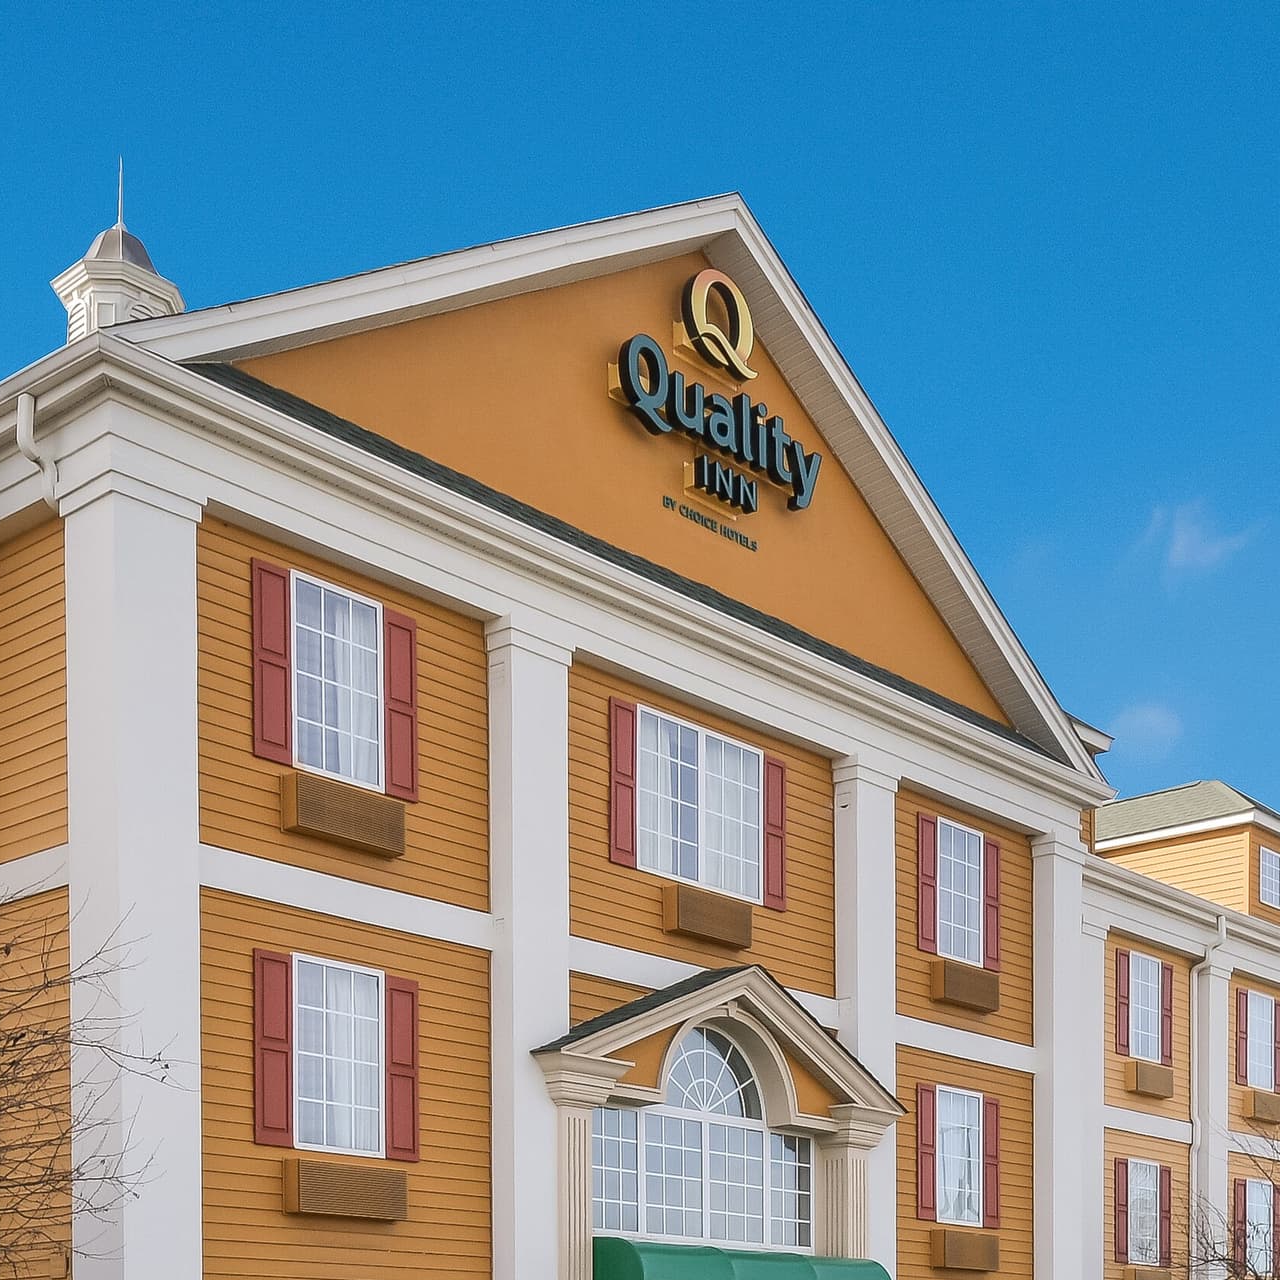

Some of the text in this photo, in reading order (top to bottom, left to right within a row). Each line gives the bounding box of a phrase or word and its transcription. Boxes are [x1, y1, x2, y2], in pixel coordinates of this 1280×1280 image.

[681, 268, 759, 381] Q
[618, 333, 822, 512] Quality
[663, 495, 758, 552] BY CHOICE HOTELS
[694, 454, 758, 515] INN
